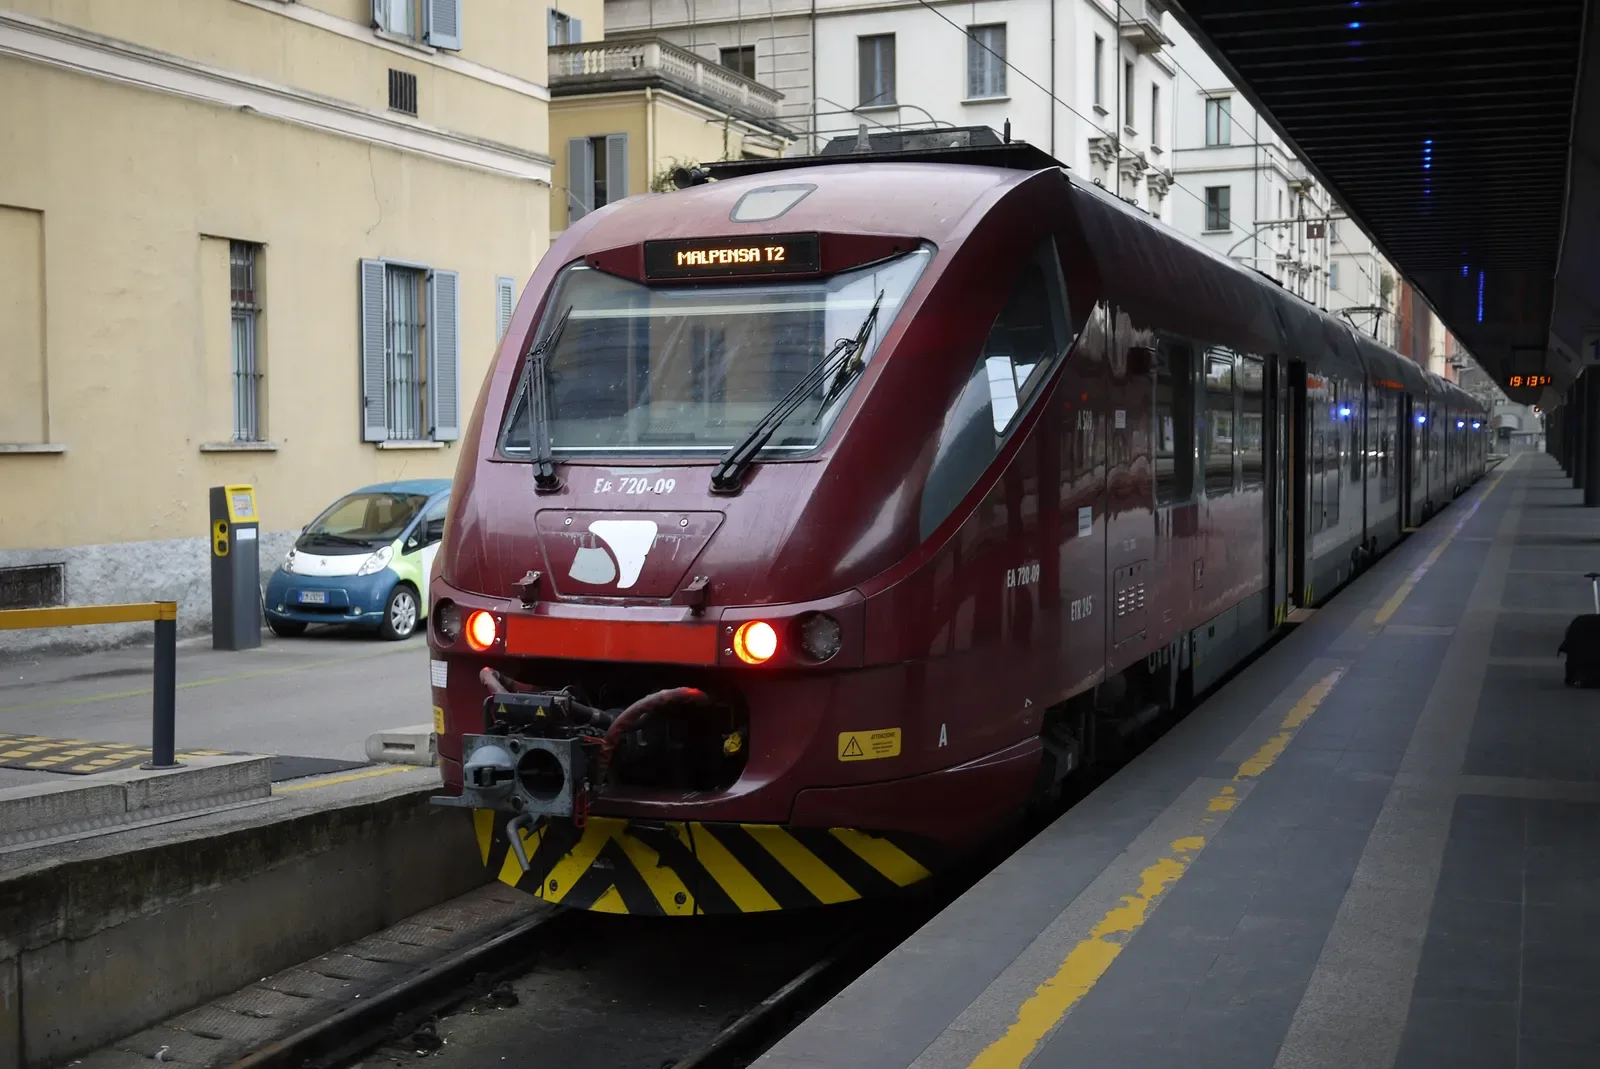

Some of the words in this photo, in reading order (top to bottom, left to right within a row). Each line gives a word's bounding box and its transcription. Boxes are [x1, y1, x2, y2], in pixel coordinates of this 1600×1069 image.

[676, 247, 761, 266] MALPENSA
[764, 246, 785, 261] T2
[617, 477, 676, 494] 720-09
[1007, 568, 1016, 588] EA
[938, 723, 948, 748] A
